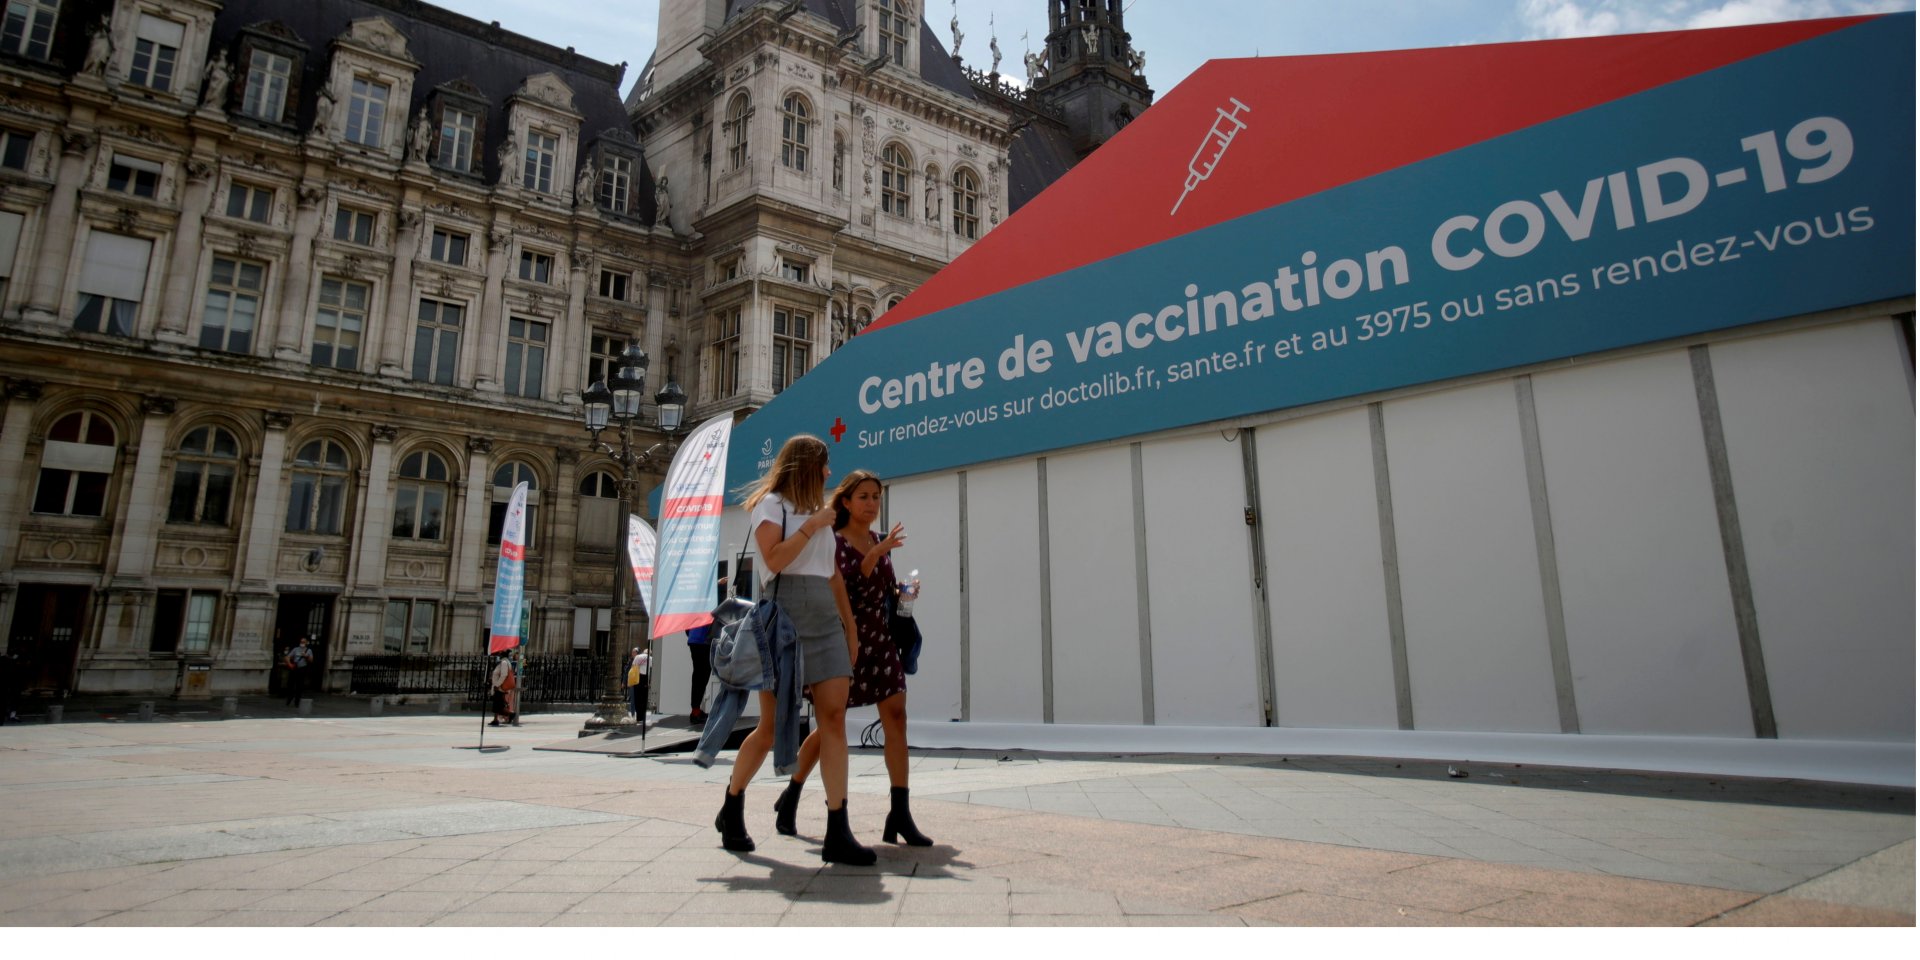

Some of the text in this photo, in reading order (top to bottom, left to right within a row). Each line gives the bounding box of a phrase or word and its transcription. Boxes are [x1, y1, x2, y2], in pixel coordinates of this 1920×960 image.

[858, 116, 1854, 415] Centre de vaccination COVID-19
[858, 206, 1875, 449] Sur rendez-vous sur doctolib.fr, sante.fr et au 3975 ou sans rendez-vous
[757, 458, 776, 470] PARIS
[676, 503, 713, 513] COVID-19
[667, 547, 715, 556] vacnation
